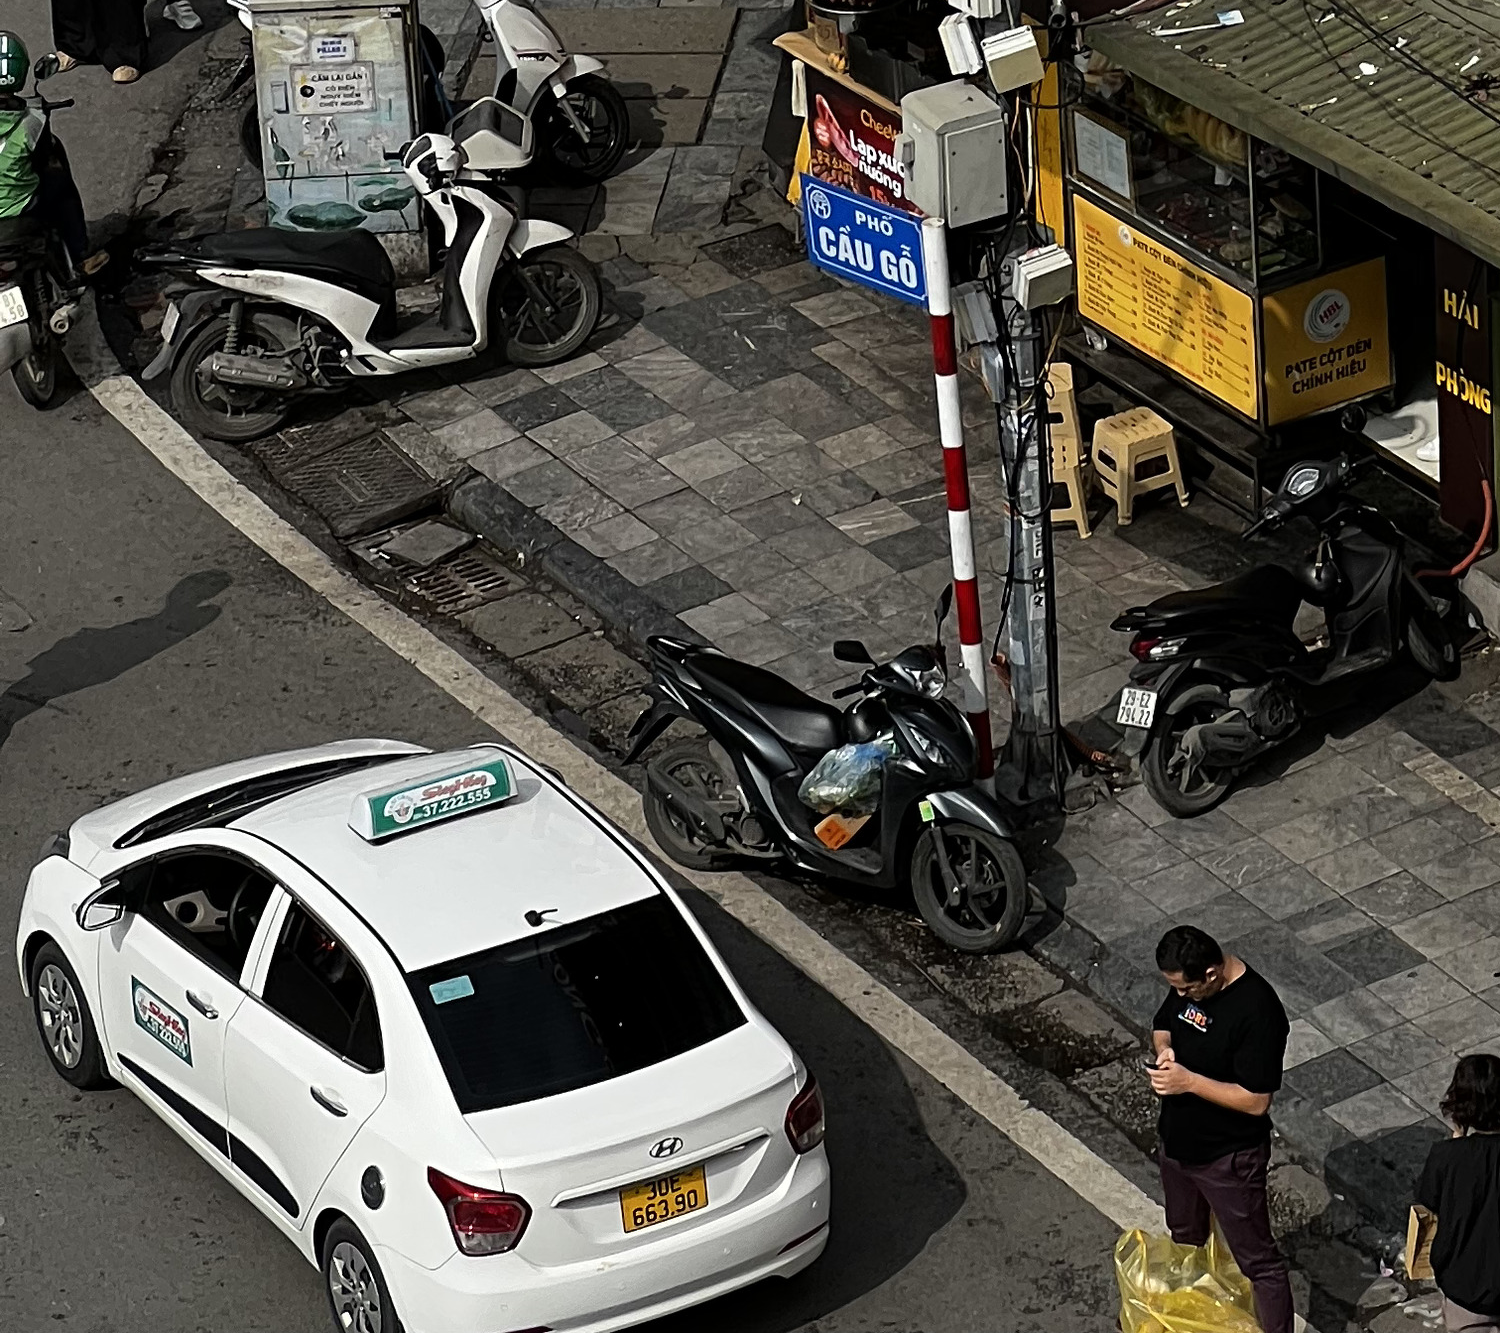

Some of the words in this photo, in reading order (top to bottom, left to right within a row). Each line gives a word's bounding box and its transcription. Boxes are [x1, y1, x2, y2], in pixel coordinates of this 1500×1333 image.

[855, 209, 893, 236] PHỐ
[819, 224, 875, 272] CẦU
[880, 244, 918, 289] GỖ
[1318, 300, 1344, 324] HBL
[1444, 288, 1479, 330] HẢI
[1286, 357, 1317, 378] PATE
[1319, 347, 1345, 368] CỘT
[1292, 370, 1333, 394] CHÍNH
[1336, 358, 1366, 381] HIỆU
[423, 788, 491, 817] 37.222.555
[645, 1176, 681, 1200] 30E
[633, 1190, 697, 1226] 663.90
